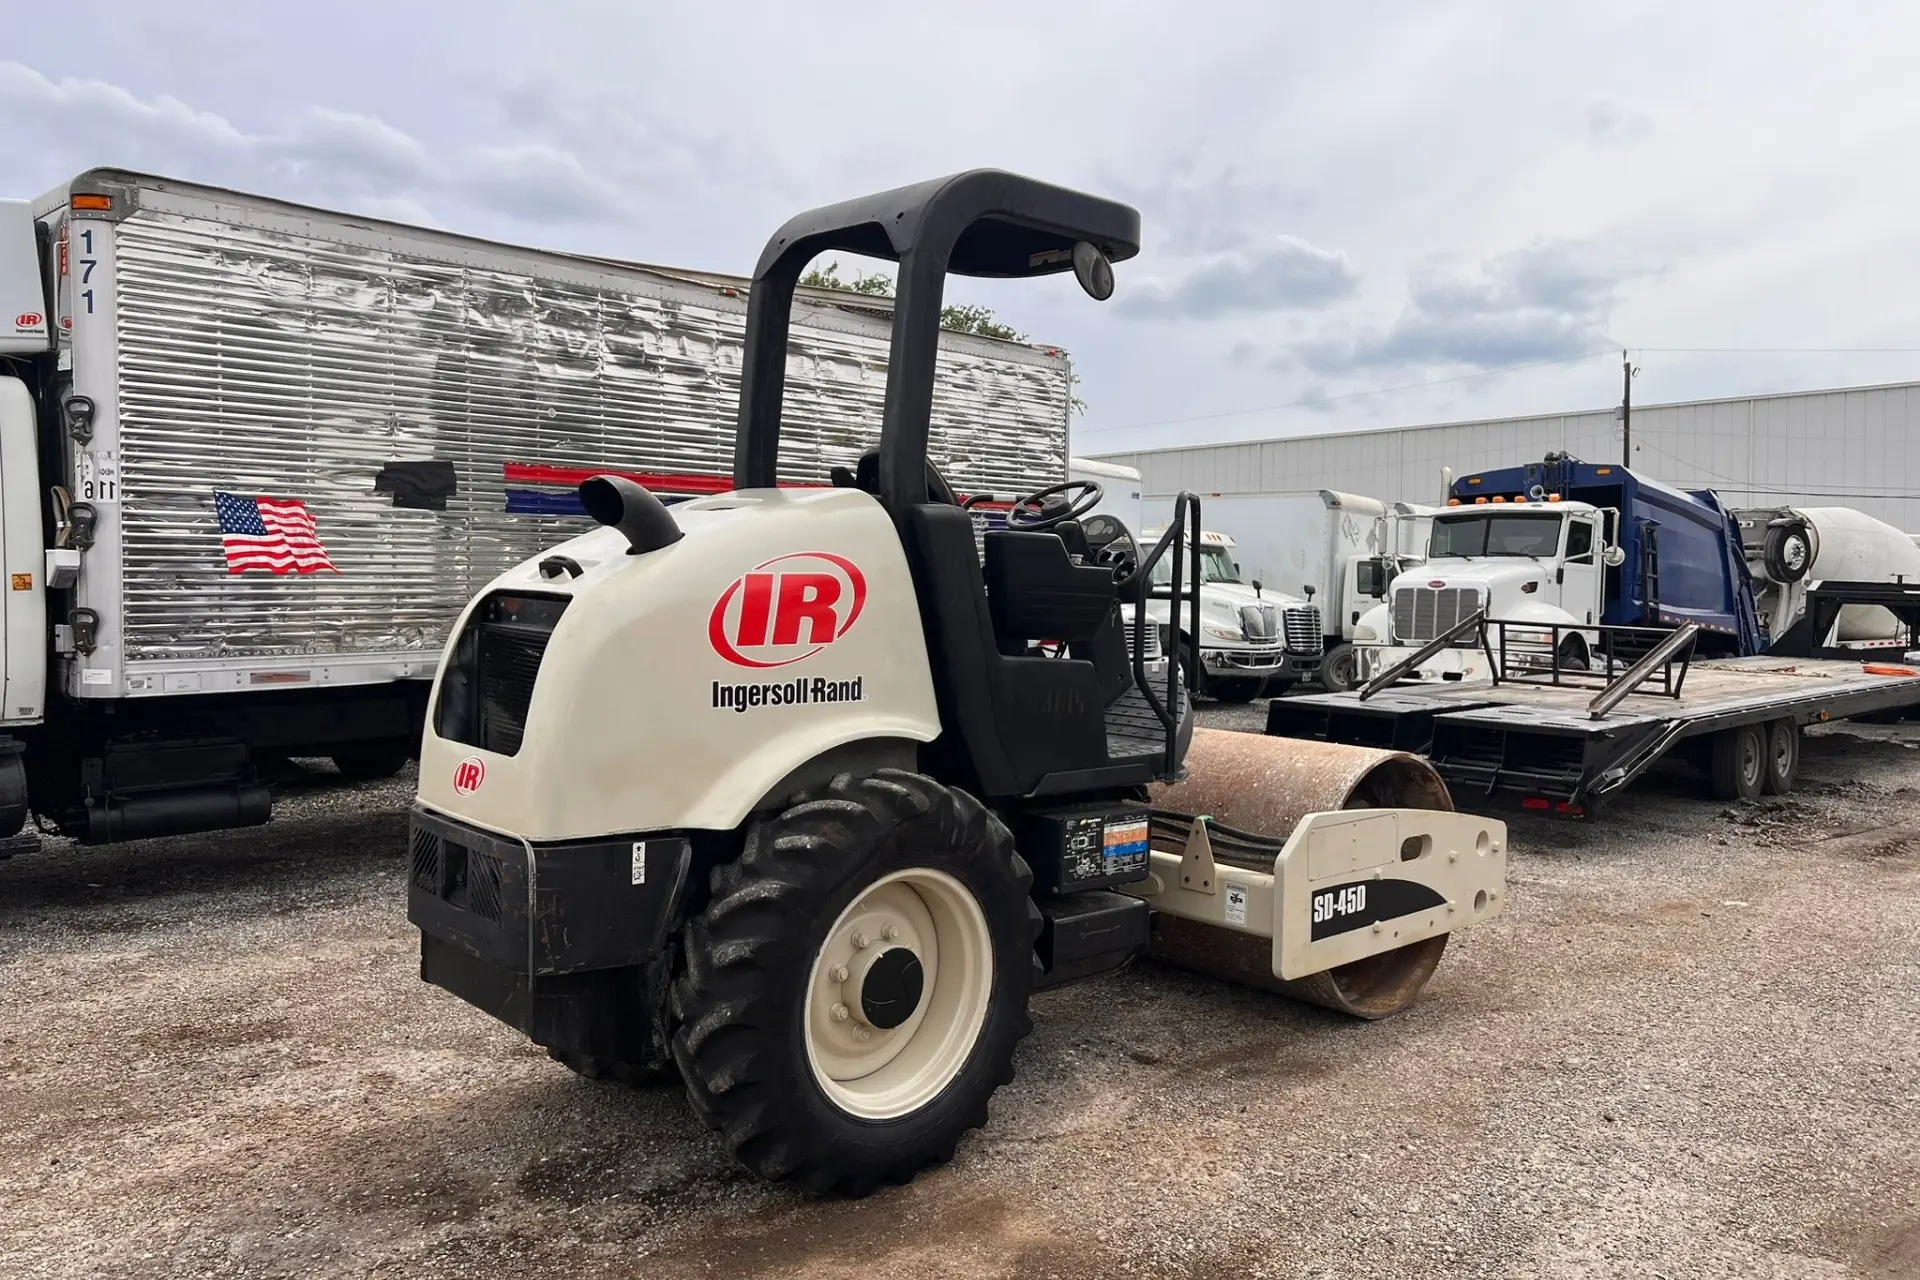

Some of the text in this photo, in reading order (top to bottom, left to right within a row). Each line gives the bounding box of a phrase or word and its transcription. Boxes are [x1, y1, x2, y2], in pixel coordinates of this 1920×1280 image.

[735, 573, 842, 648] IR
[711, 675, 863, 713] Ingersoll-Rand
[457, 761, 480, 792] IR
[1313, 884, 1367, 923] SD-45D
